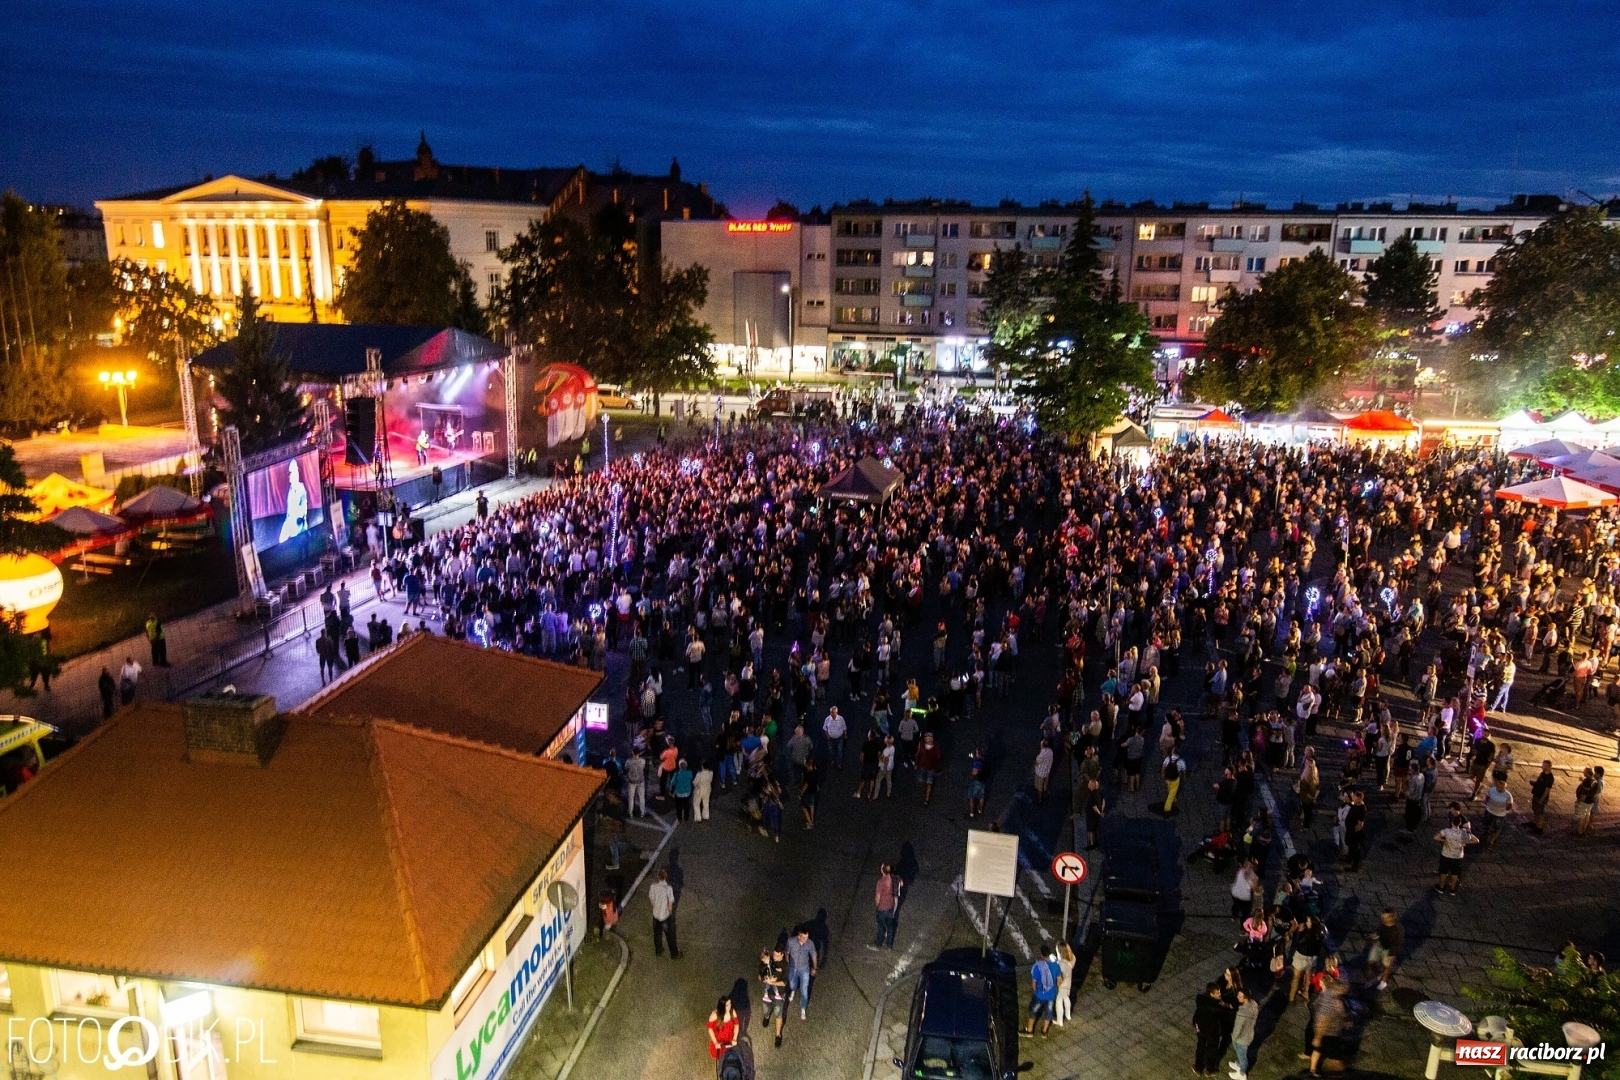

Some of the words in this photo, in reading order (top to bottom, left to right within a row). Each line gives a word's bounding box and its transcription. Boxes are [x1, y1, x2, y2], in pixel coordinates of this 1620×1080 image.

[728, 222, 752, 232] BLACK
[753, 222, 768, 232] RED
[513, 998, 526, 1025] Call
[526, 984, 537, 1005] the
